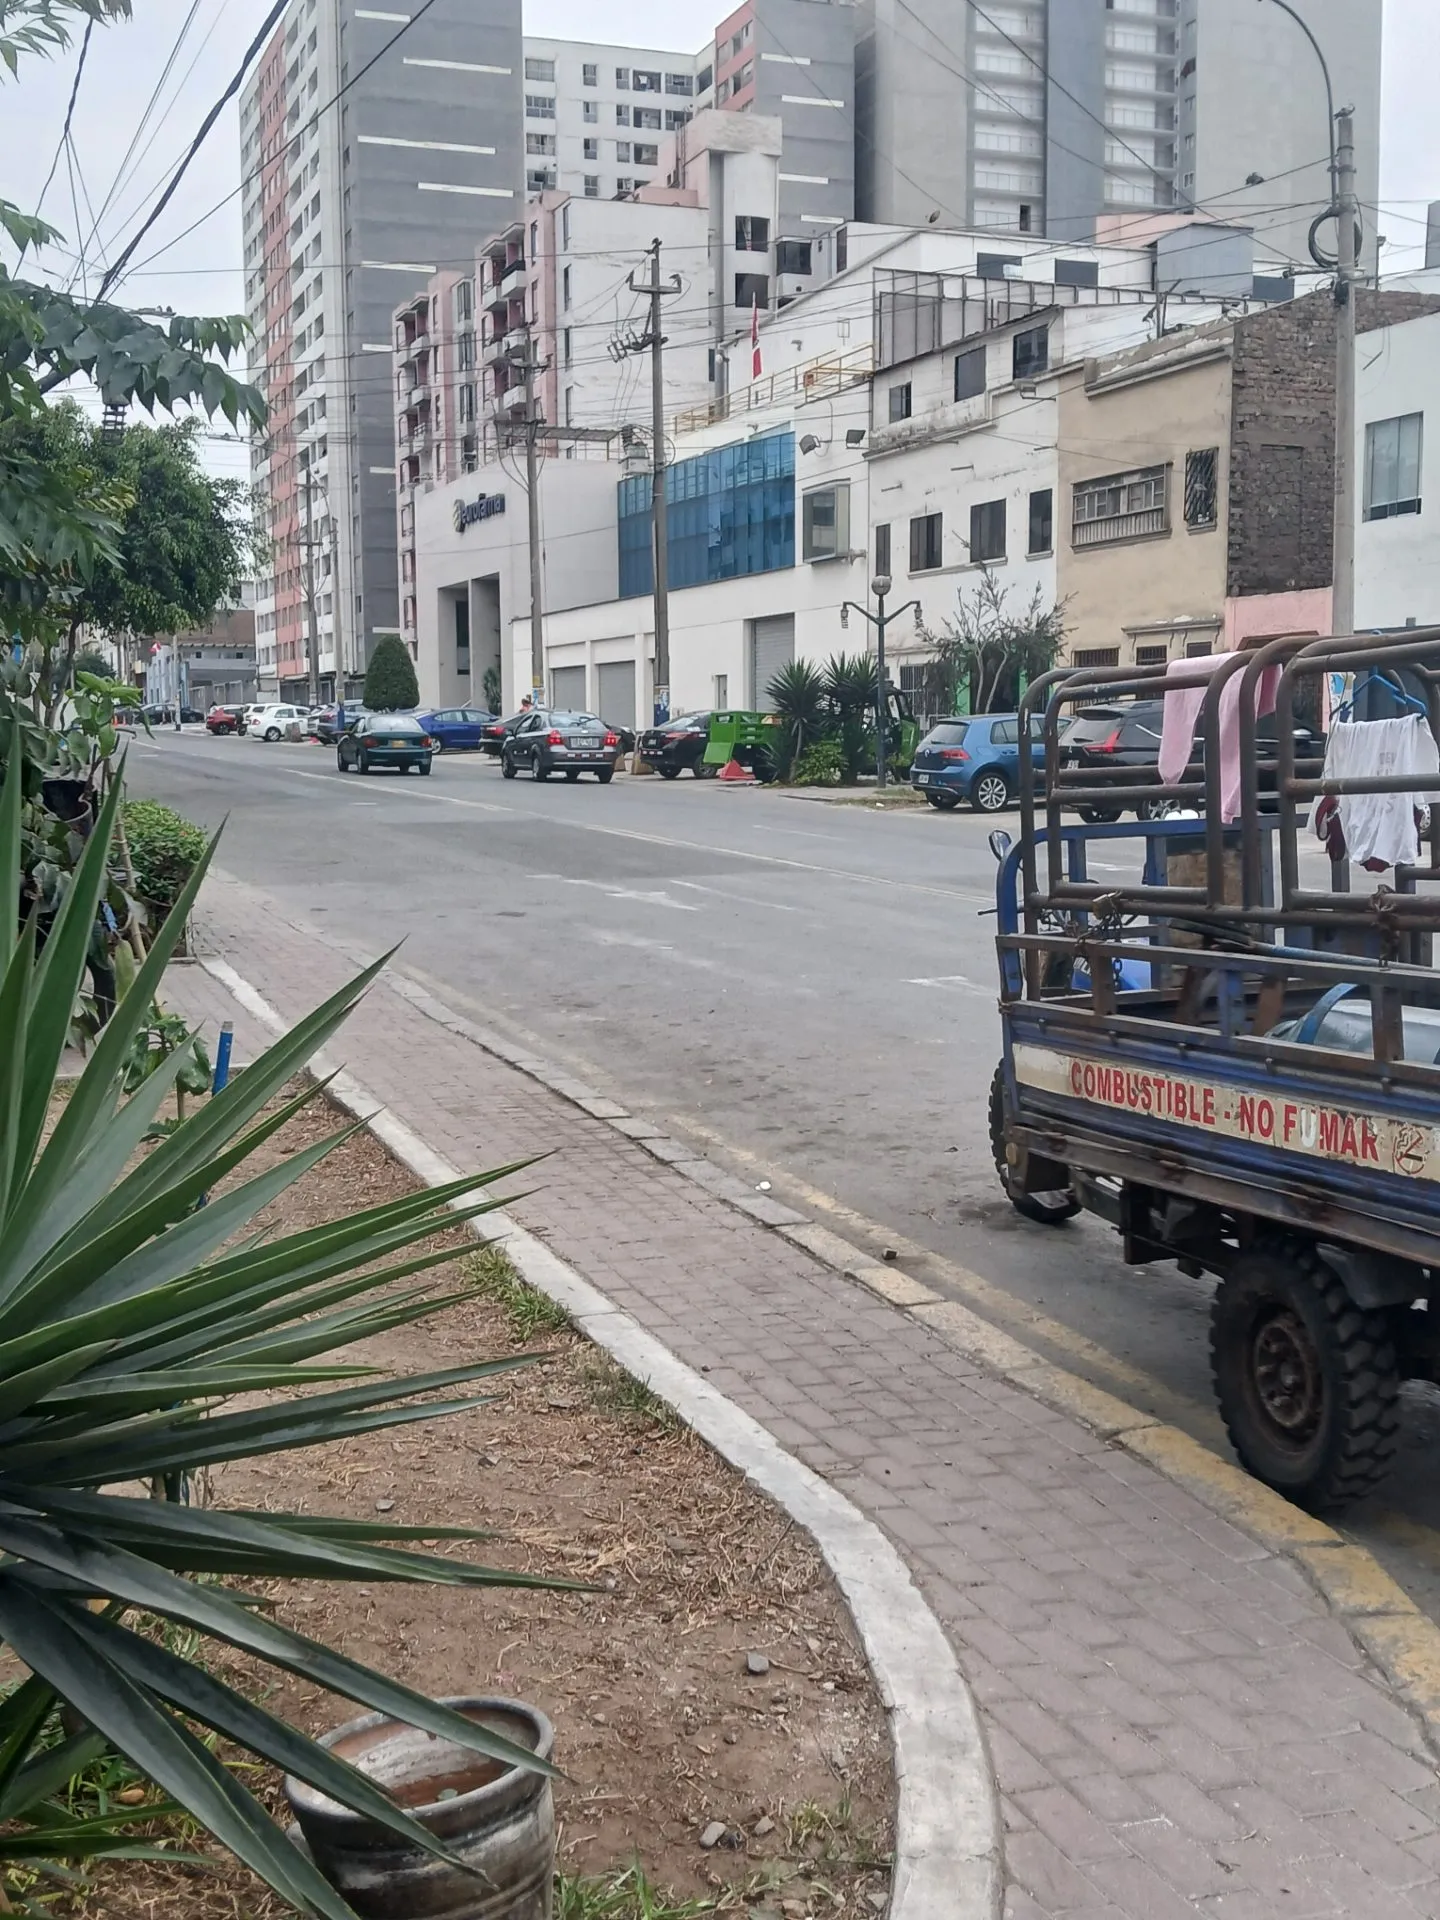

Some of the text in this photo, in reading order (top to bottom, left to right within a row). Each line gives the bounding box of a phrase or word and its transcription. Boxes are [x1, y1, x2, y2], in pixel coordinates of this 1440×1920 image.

[1071, 1061, 1216, 1125] COMBUSTIBLE
[1240, 1095, 1275, 1138] NO
[1284, 1104, 1379, 1162] FUMAR
